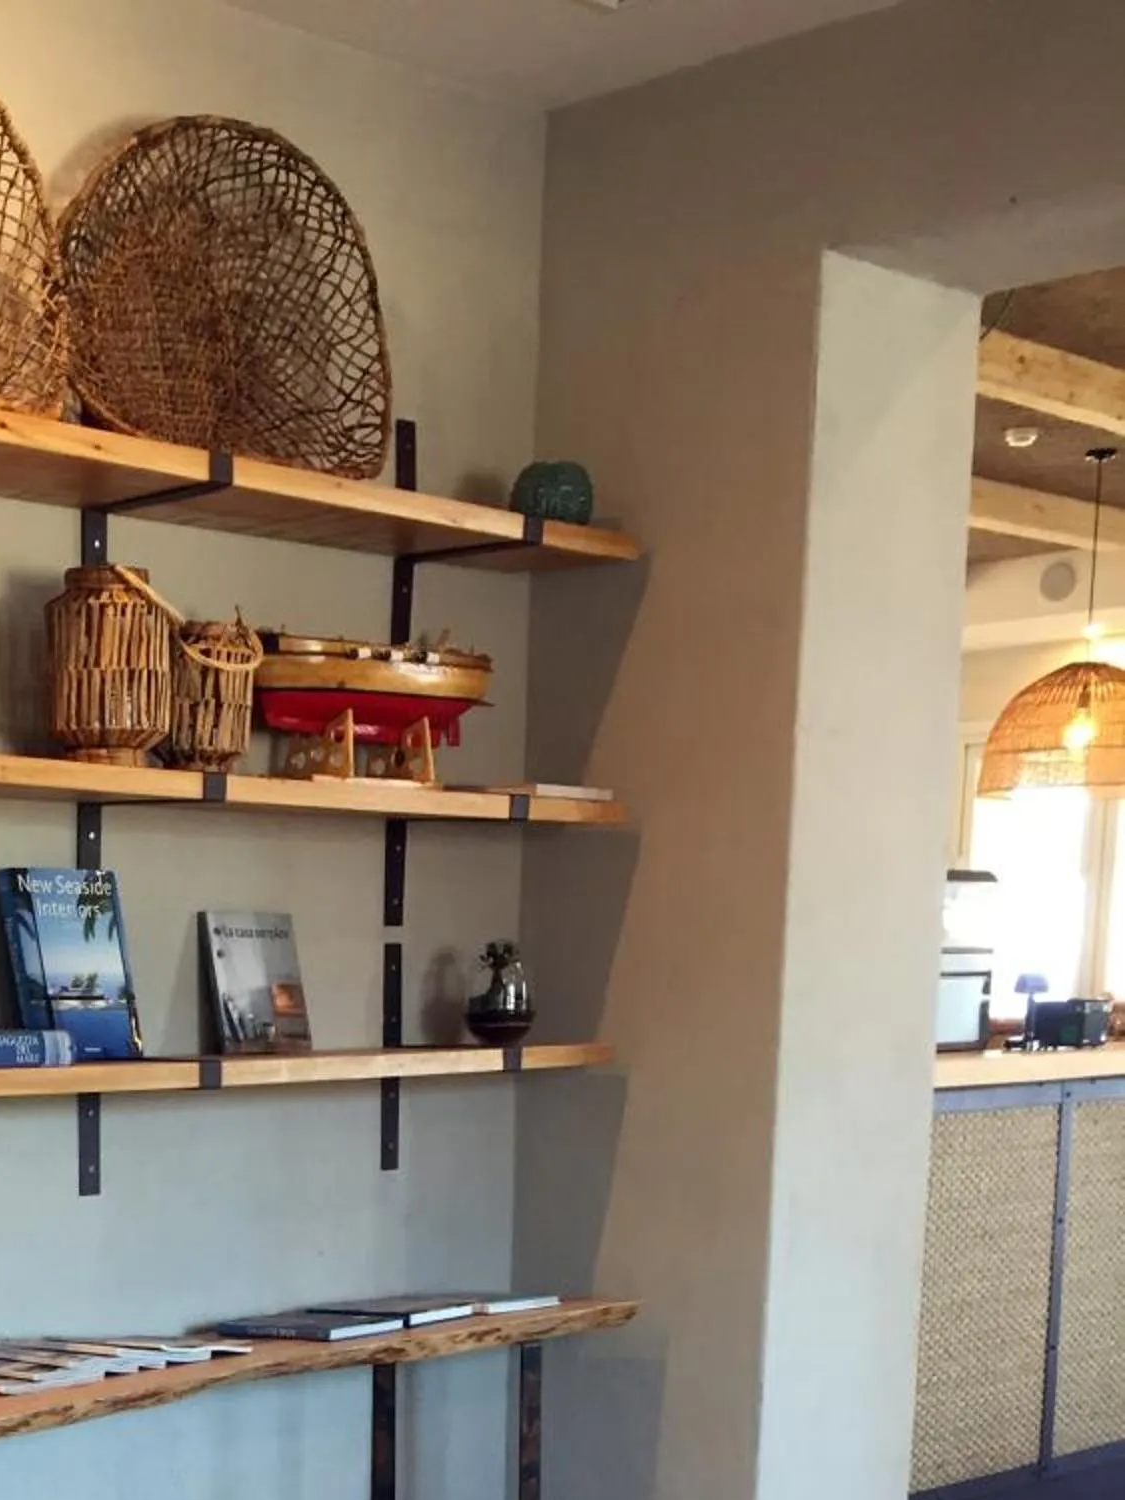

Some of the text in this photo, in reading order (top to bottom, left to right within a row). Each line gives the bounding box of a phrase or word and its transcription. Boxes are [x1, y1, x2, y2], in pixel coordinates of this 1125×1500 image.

[16, 873, 112, 897] New Seaside
[36, 899, 100, 919] Interiors
